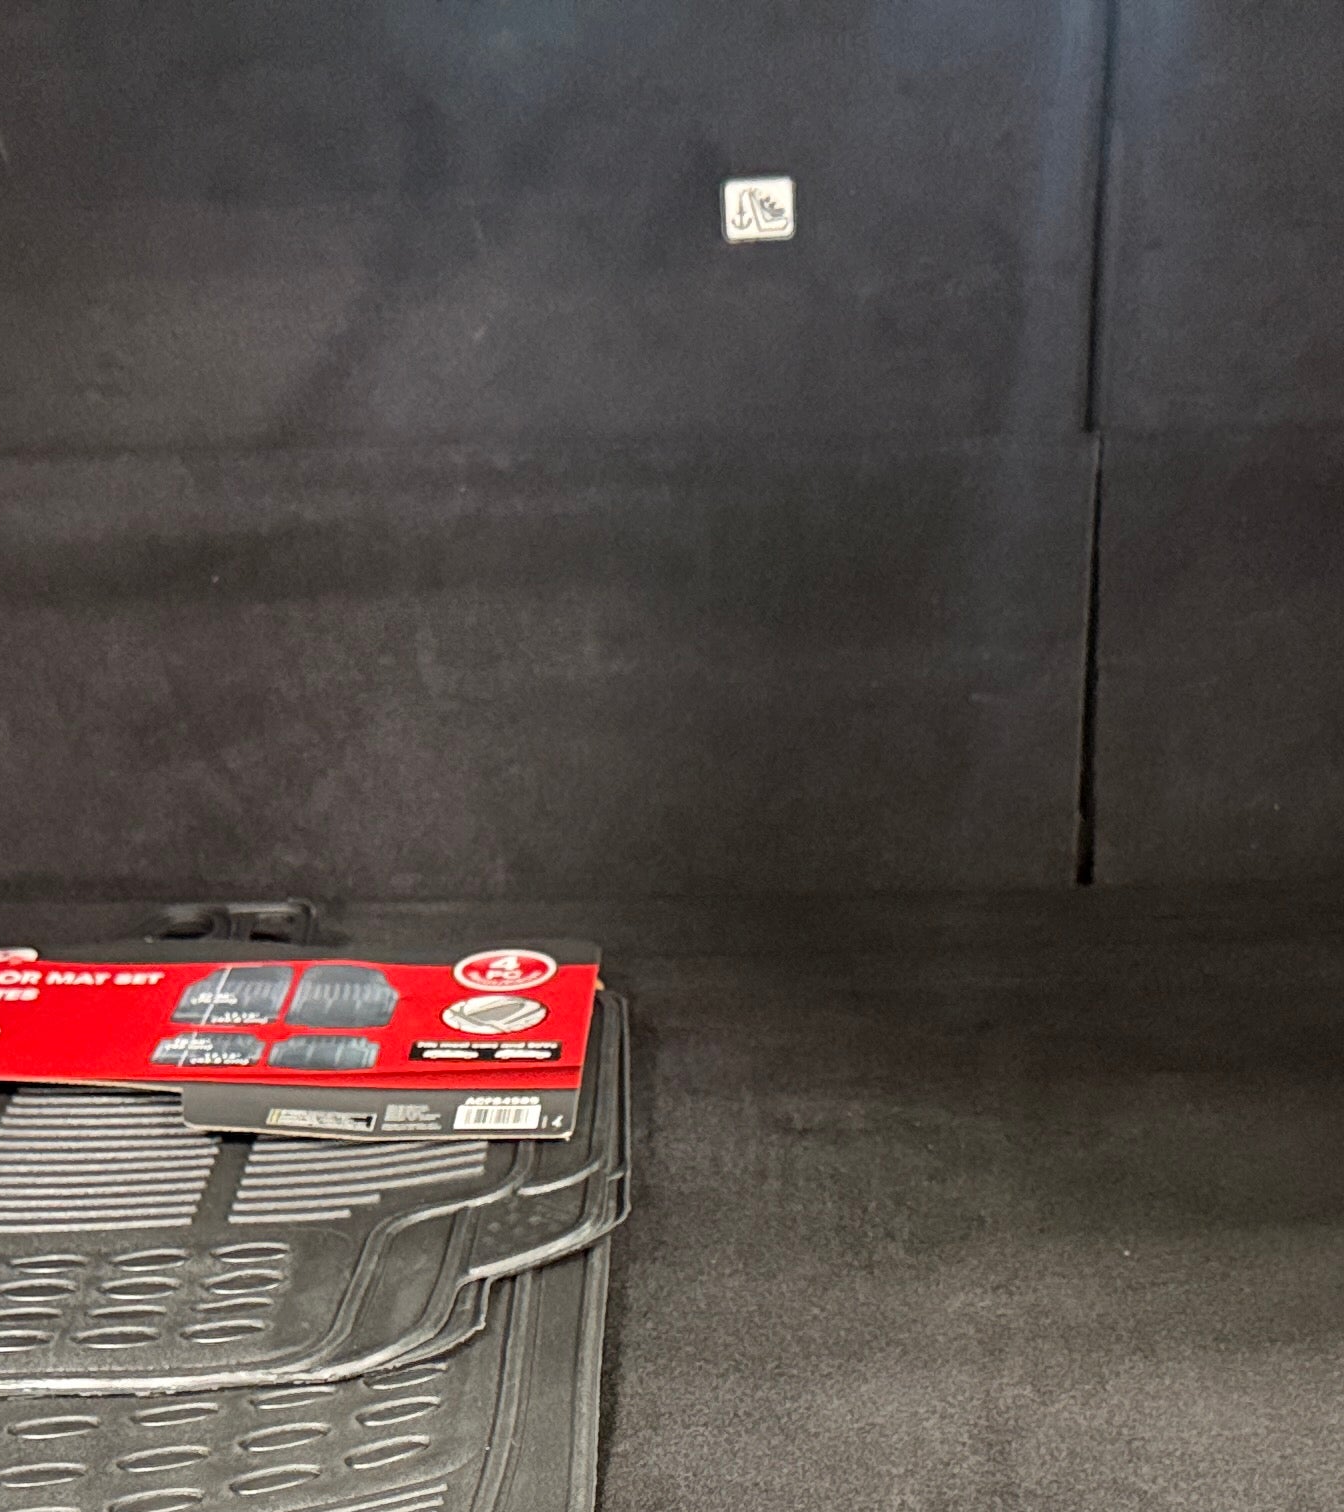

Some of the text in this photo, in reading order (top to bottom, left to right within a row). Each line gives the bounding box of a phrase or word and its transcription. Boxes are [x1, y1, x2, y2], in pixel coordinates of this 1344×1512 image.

[489, 955, 521, 970] 4
[45, 971, 112, 985] MAT
[113, 972, 165, 985] SET
